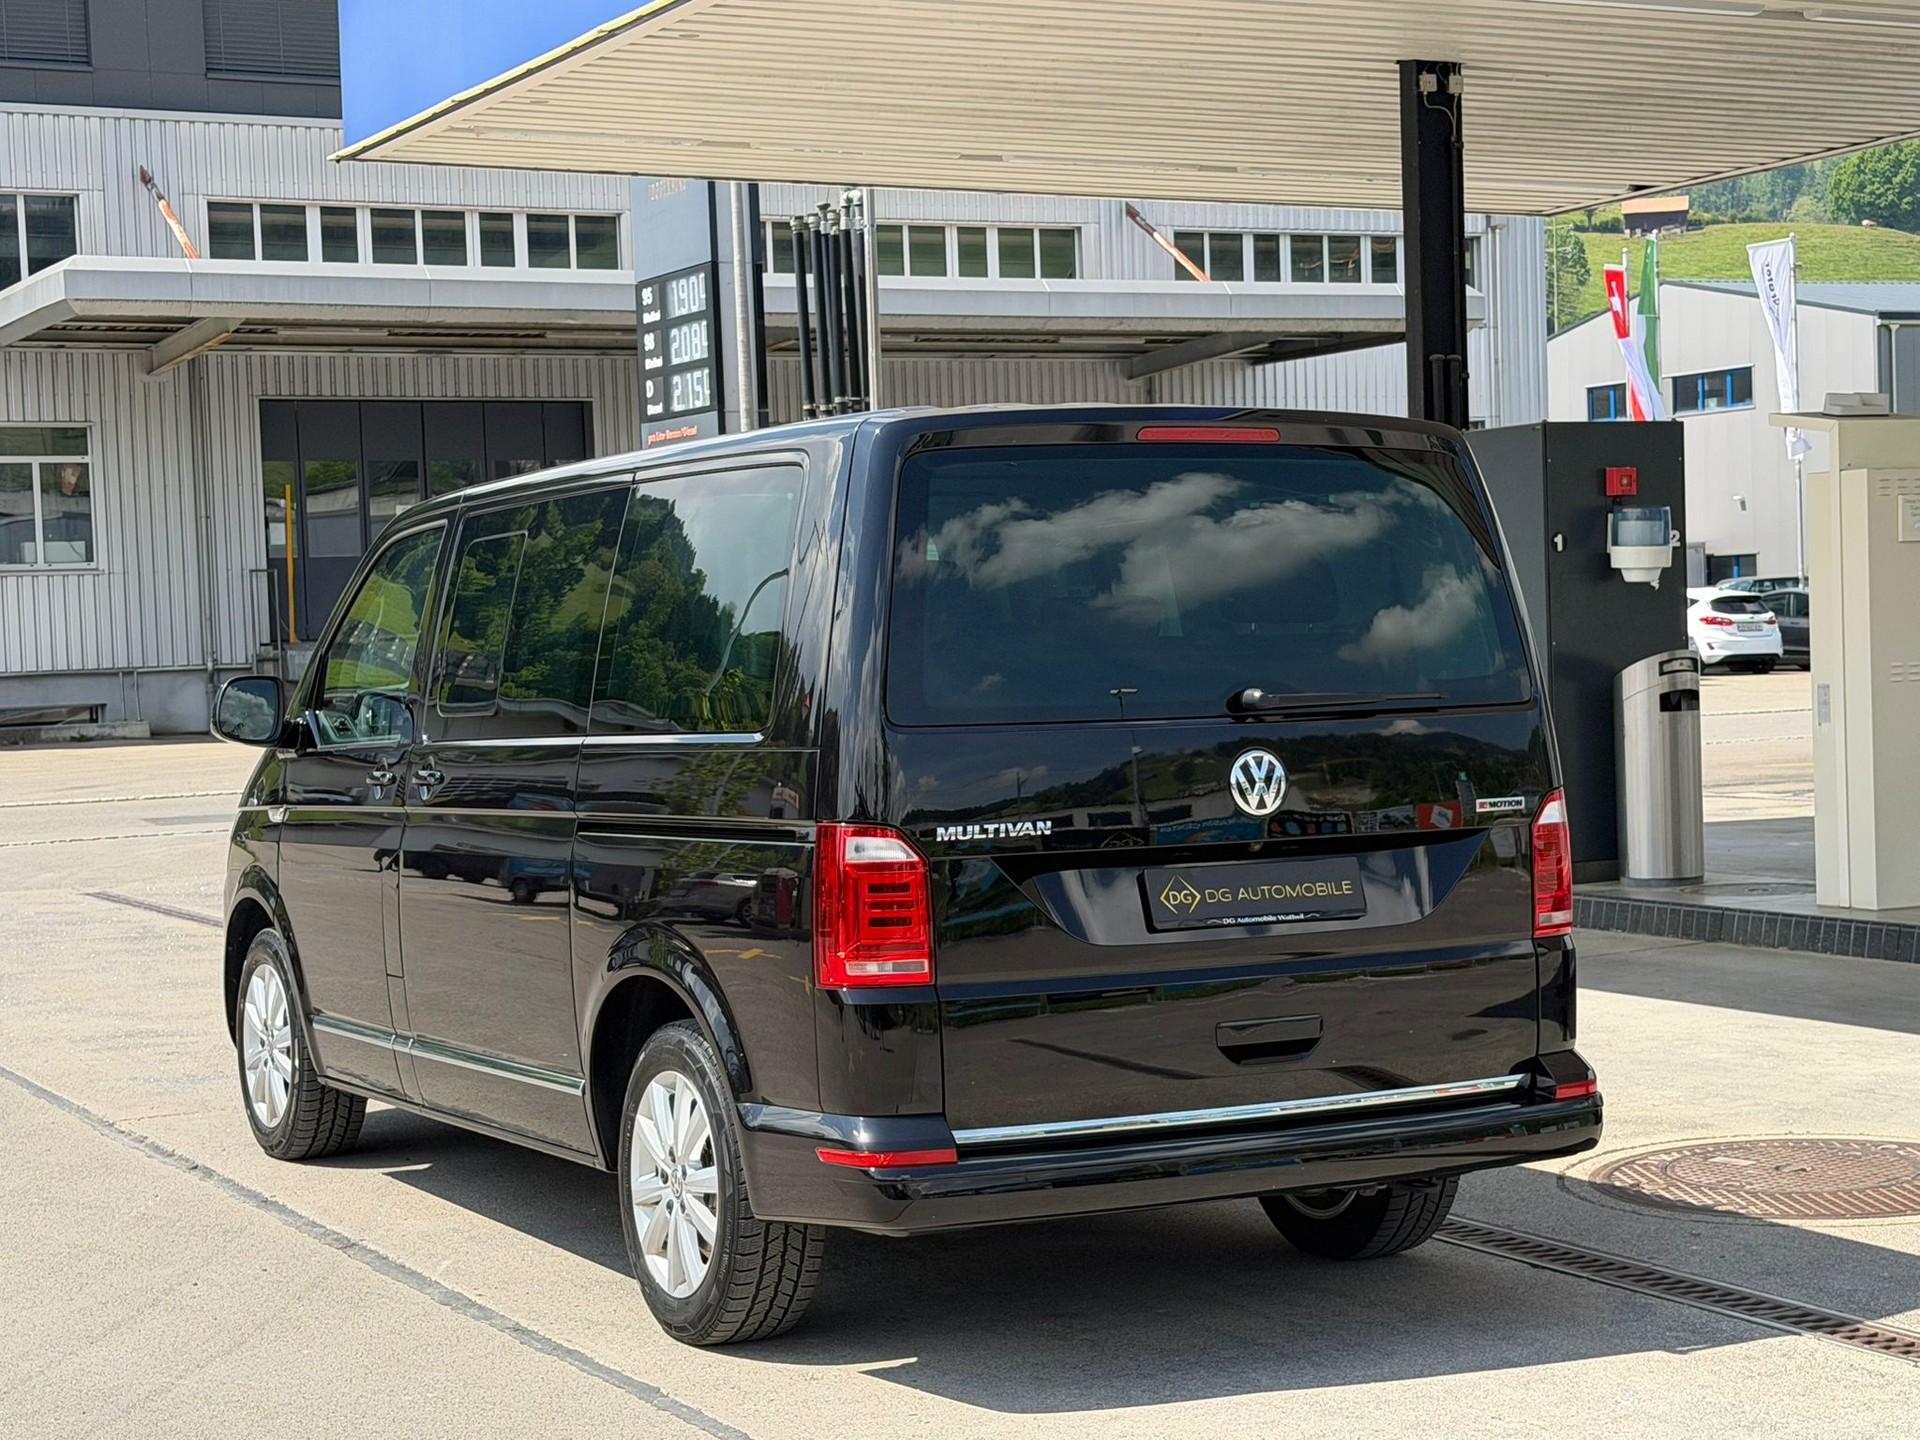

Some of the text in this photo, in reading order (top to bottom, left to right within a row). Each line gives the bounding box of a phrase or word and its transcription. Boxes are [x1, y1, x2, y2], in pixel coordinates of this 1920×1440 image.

[642, 287, 653, 306] 95
[644, 332, 655, 351] 98
[1554, 534, 1563, 551] 1
[1669, 529, 1681, 547] 2
[936, 820, 1052, 842] MULTIVAN
[1169, 890, 1192, 905] DG
[1205, 880, 1353, 903] DG AUTOMOBILE
[1237, 915, 1276, 924] Automobile
